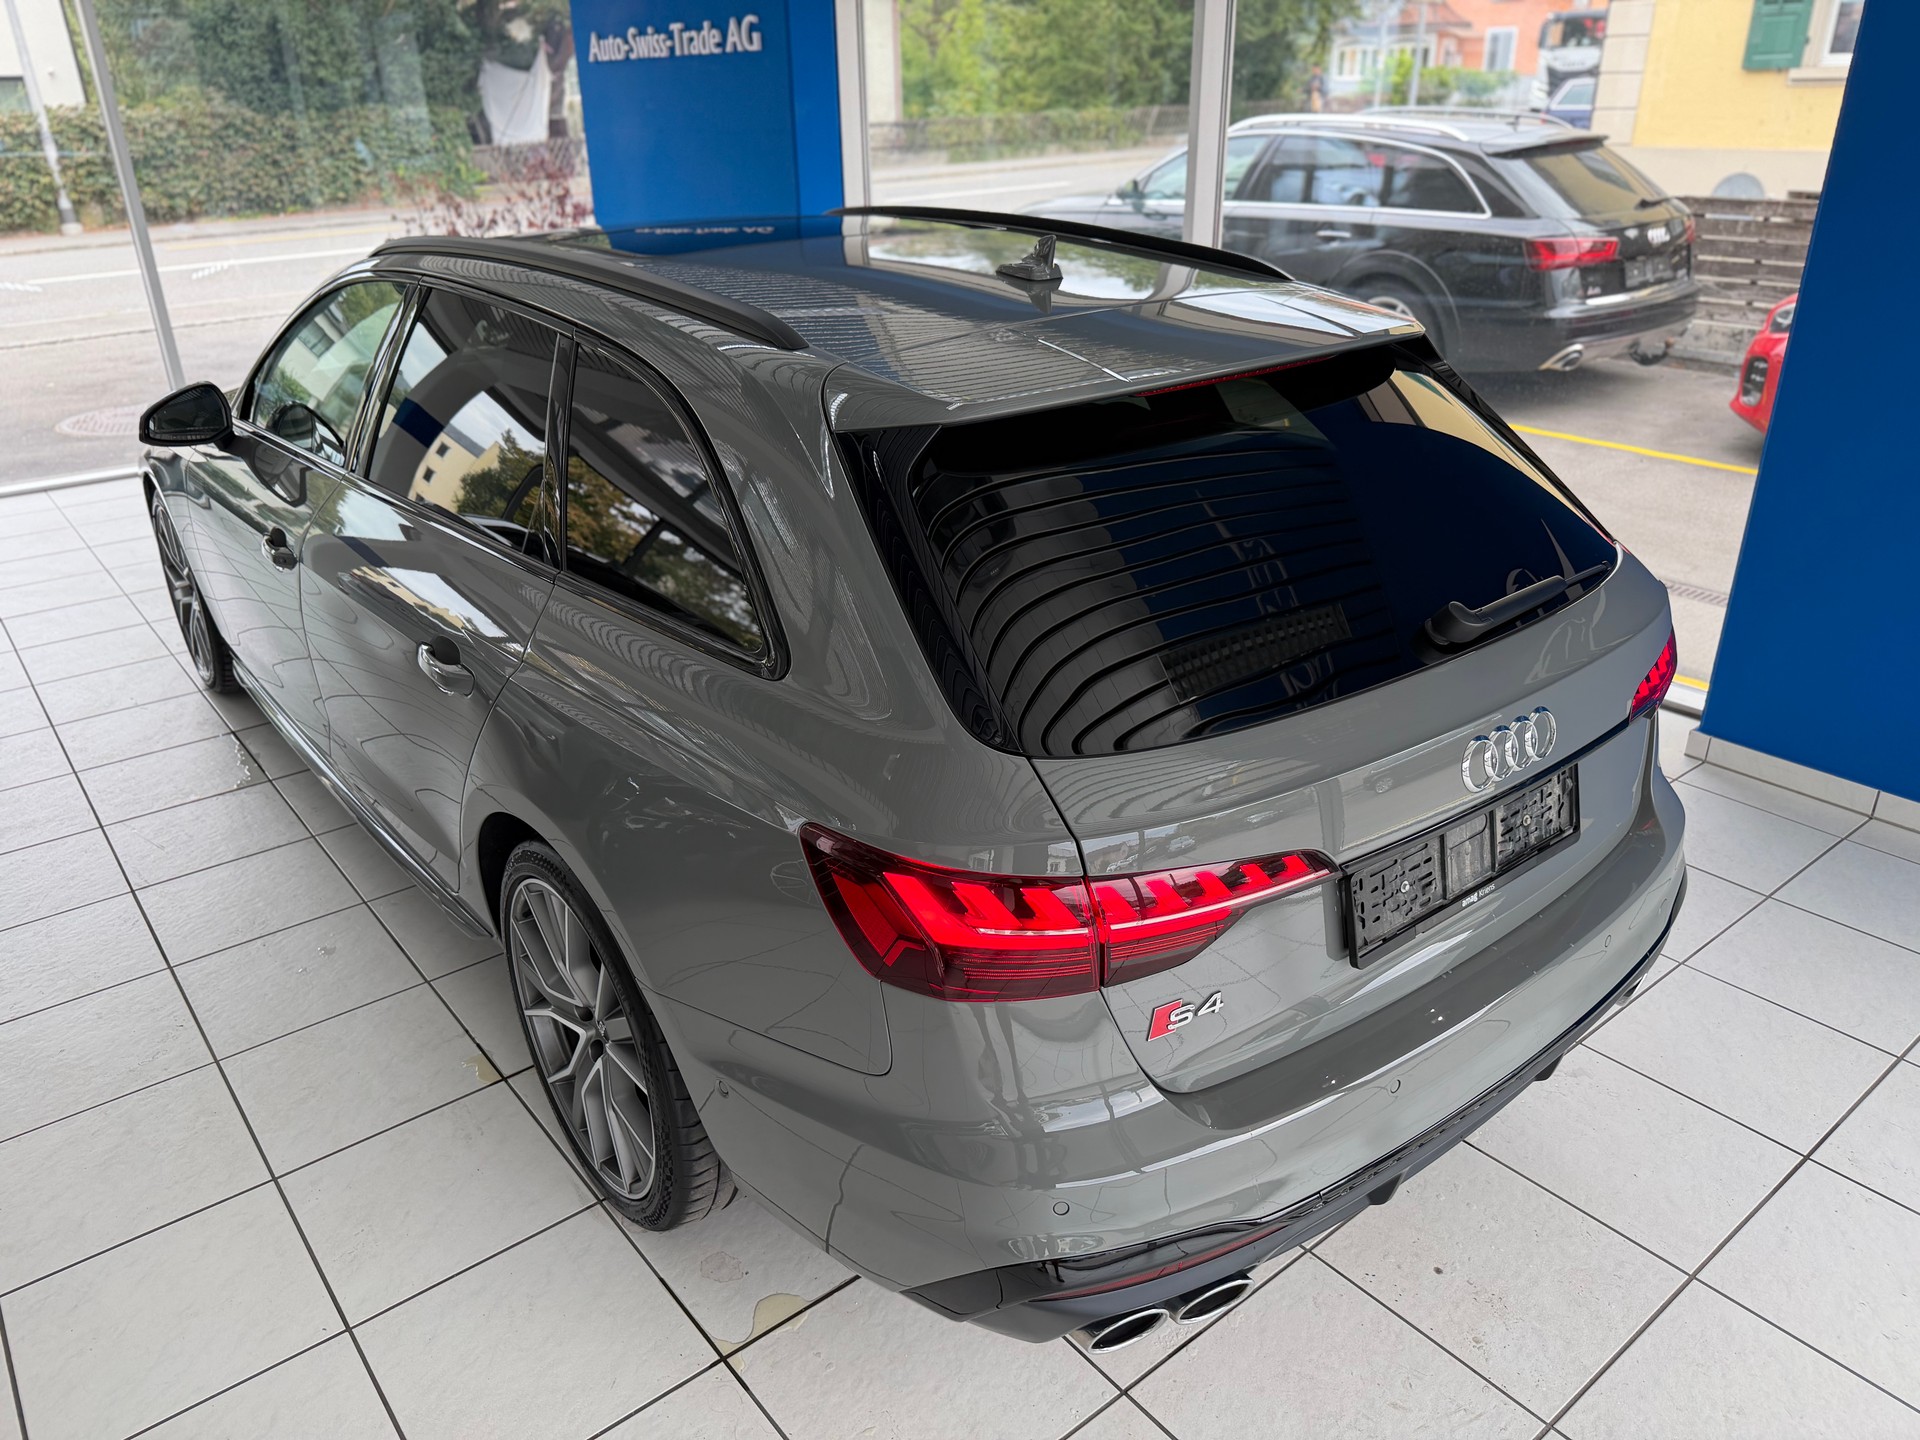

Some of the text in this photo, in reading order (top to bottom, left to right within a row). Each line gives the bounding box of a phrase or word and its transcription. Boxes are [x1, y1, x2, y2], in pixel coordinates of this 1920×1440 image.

[588, 14, 762, 63] Auto-Swiss-Trade AG
[1164, 990, 1224, 1032] S4
